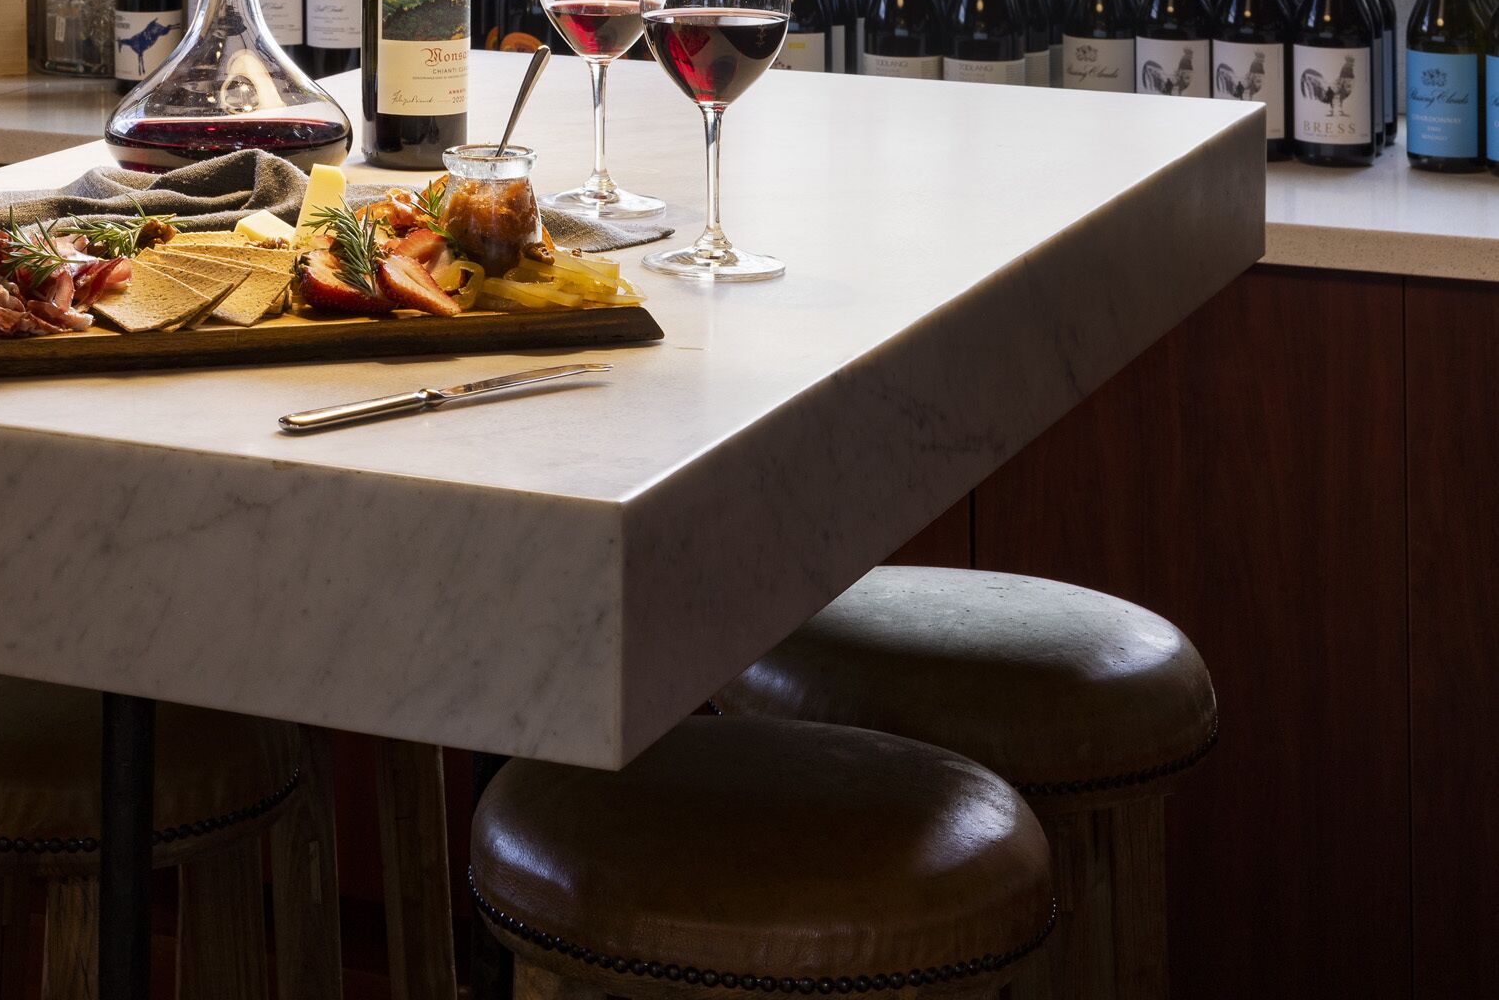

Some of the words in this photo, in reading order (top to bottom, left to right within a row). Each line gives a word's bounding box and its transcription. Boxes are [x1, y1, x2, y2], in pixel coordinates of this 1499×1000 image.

[421, 47, 467, 67] Monsa
[433, 66, 457, 75] CHIANTI
[1303, 120, 1356, 134] BRESS
